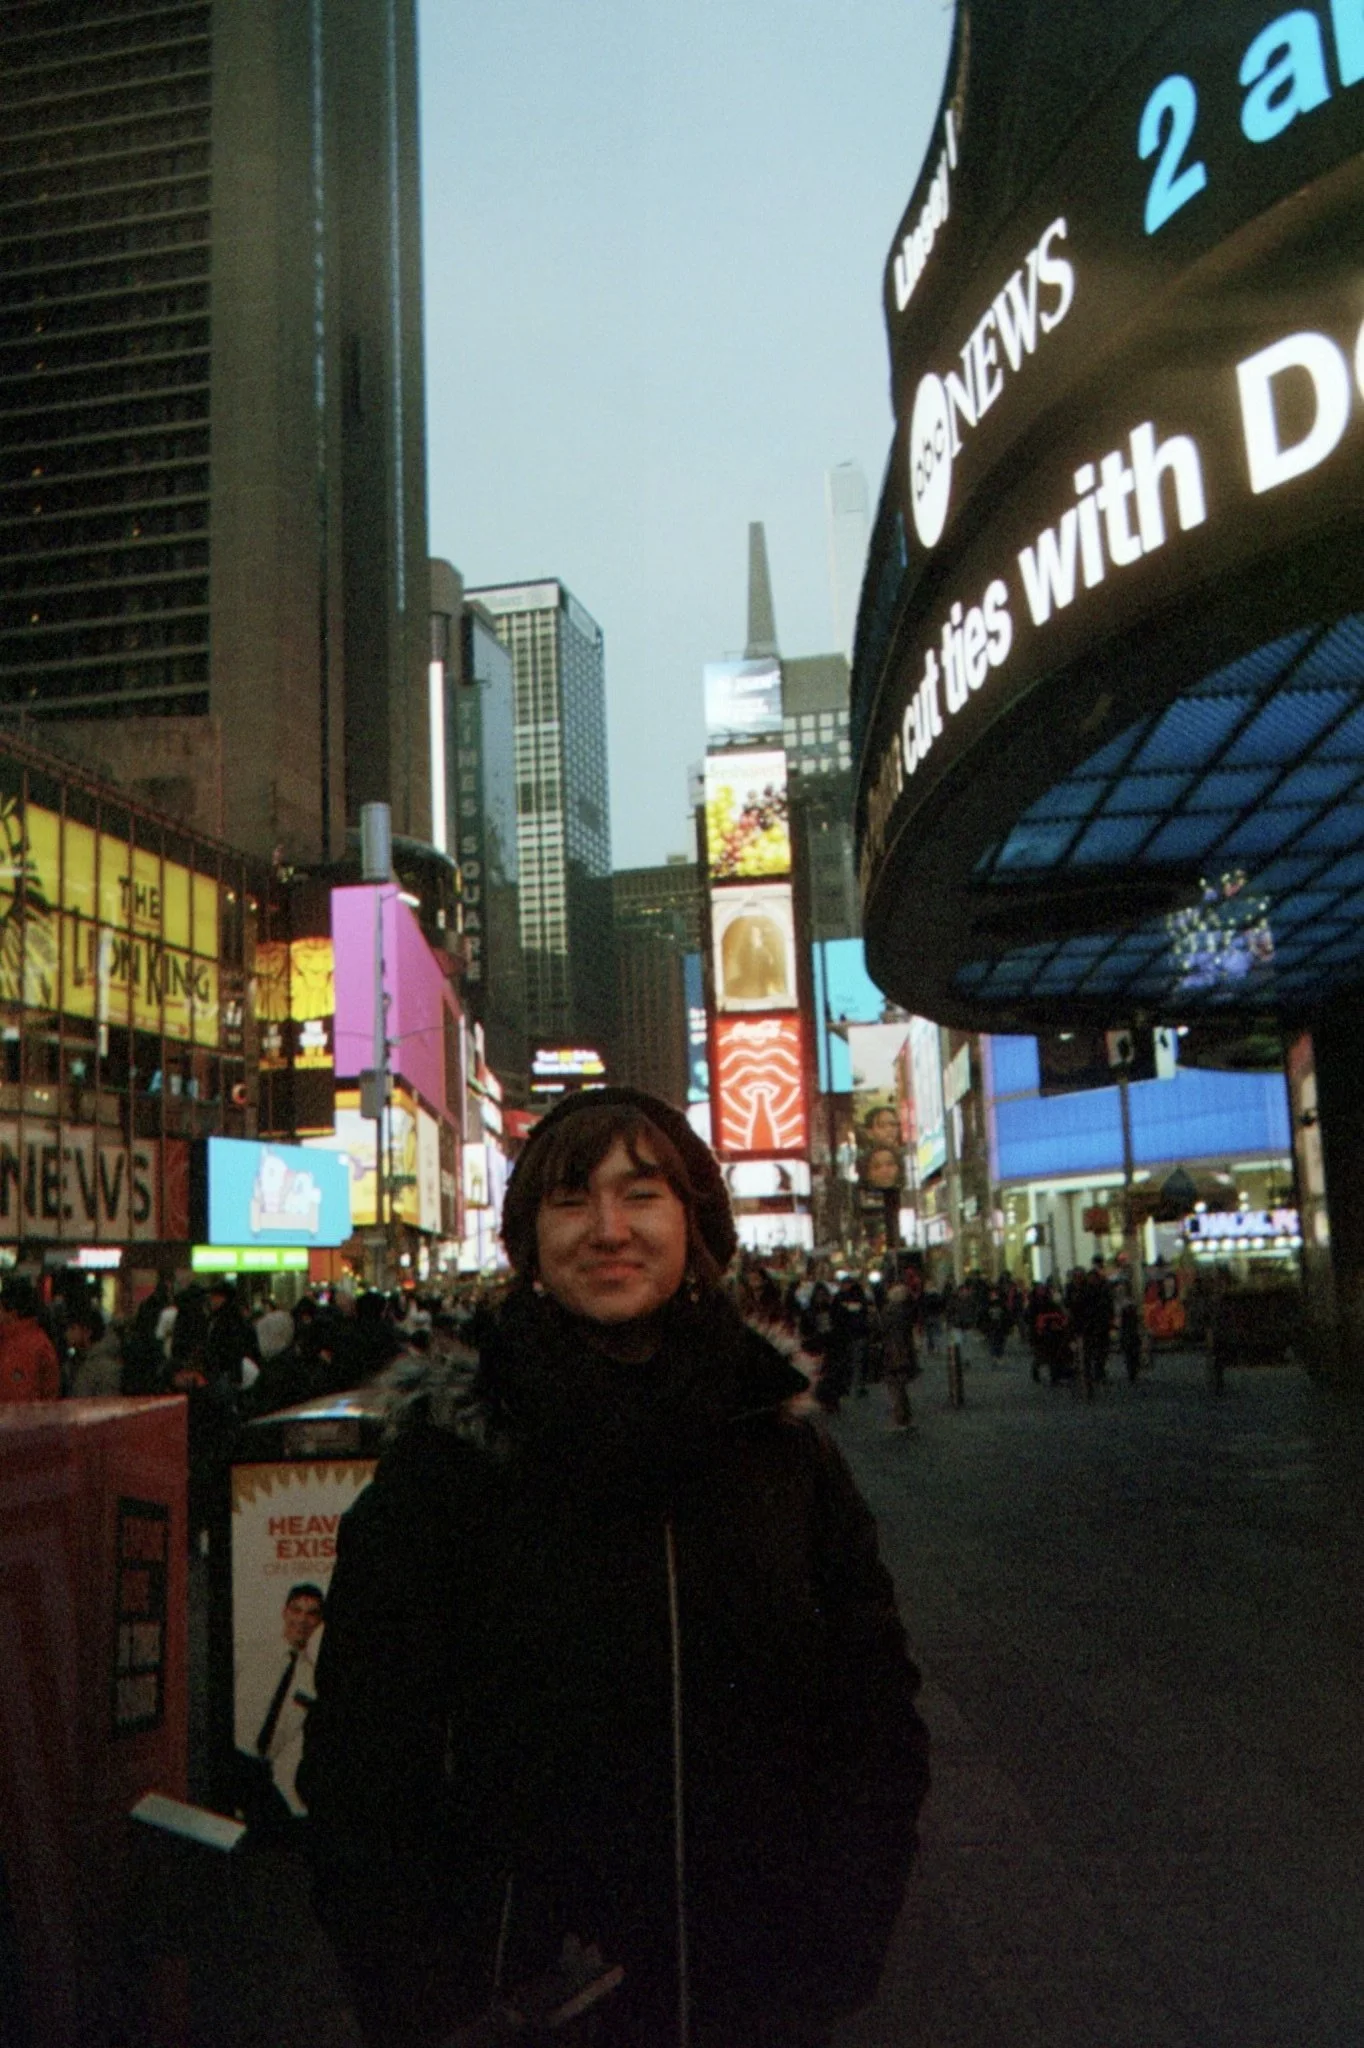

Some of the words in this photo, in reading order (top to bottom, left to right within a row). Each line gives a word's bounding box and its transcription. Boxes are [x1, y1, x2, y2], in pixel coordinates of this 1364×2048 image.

[1138, 74, 1207, 236] 2
[944, 217, 1075, 458] NEWS
[903, 648, 942, 776] cut
[941, 579, 1013, 714] ties
[1018, 420, 1207, 627] with
[1236, 312, 1364, 495] D
[457, 702, 479, 817] TIMES
[117, 874, 161, 919] THE
[460, 834, 482, 981] SQUARE
[145, 931, 210, 1006] KING
[0, 1142, 152, 1224] NEWS
[267, 1513, 340, 1536] HEAV
[275, 1538, 338, 1559] EXIS
